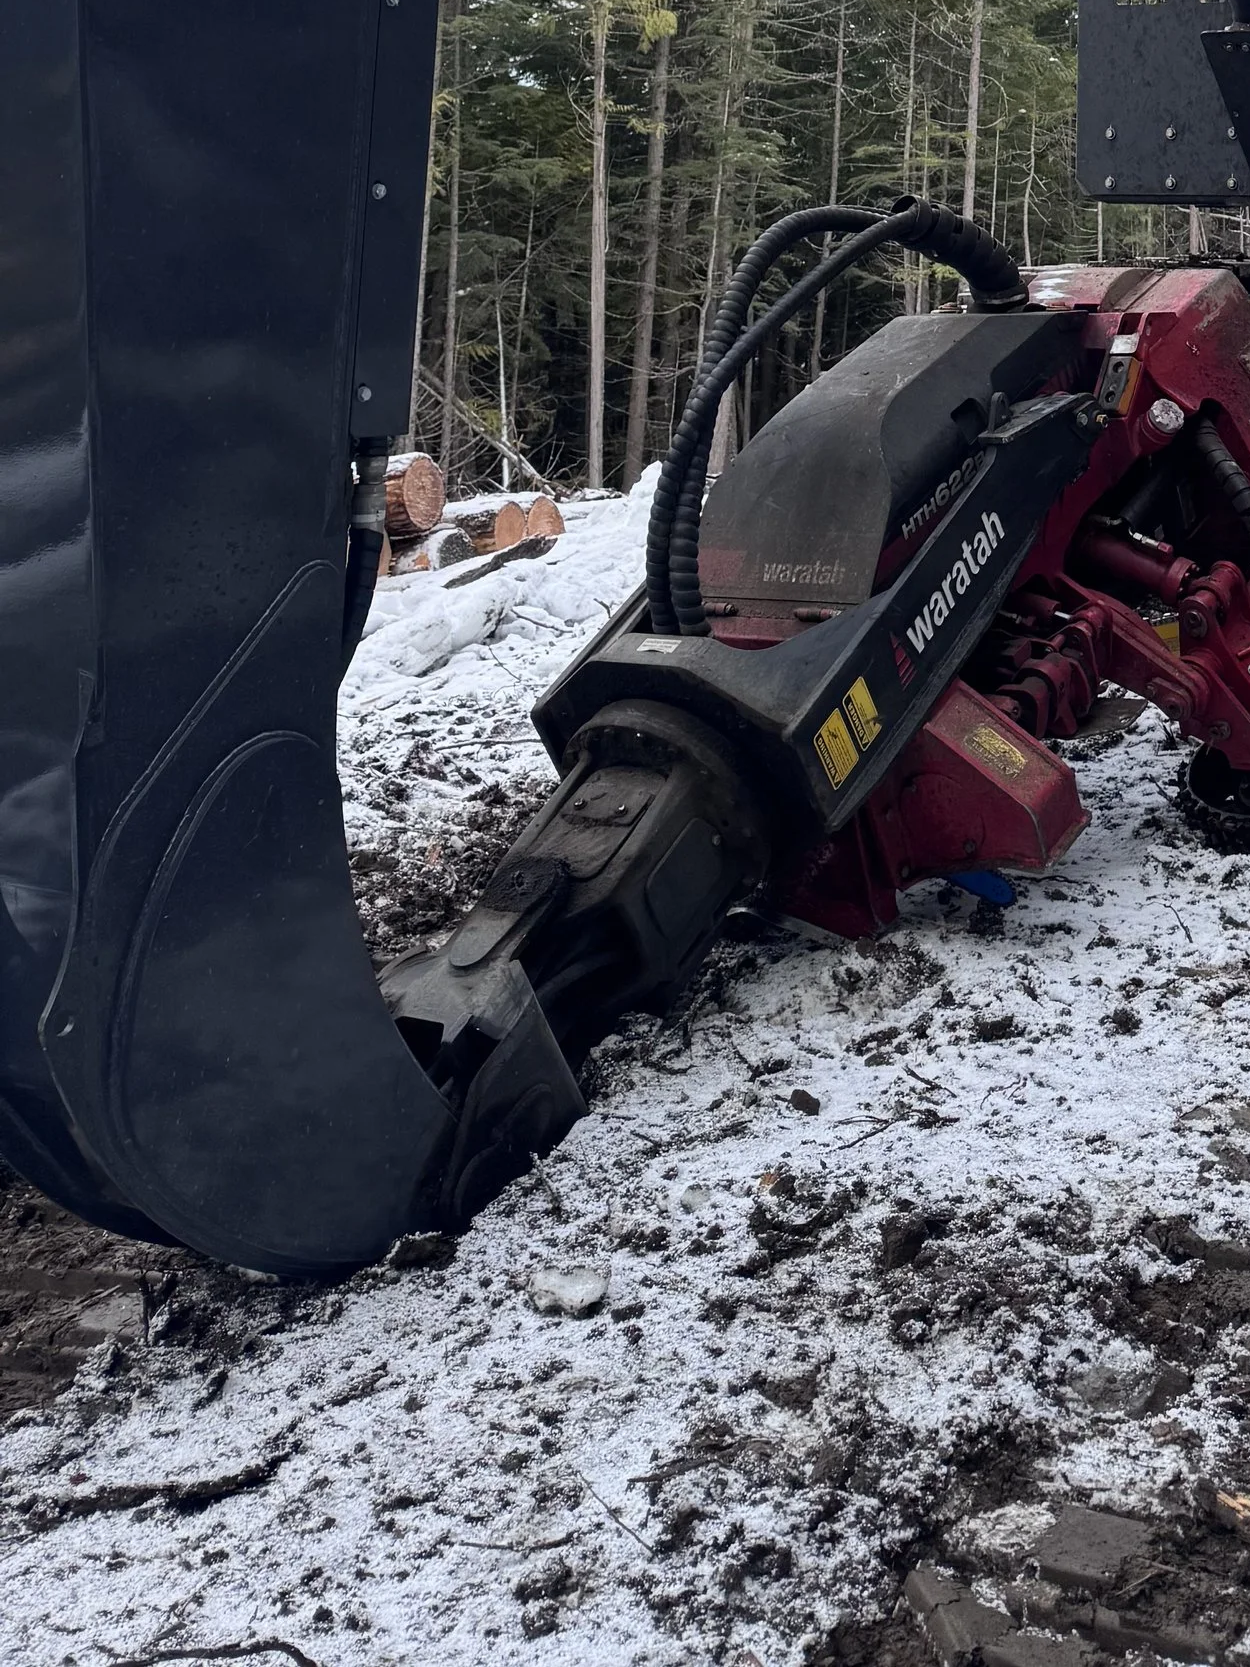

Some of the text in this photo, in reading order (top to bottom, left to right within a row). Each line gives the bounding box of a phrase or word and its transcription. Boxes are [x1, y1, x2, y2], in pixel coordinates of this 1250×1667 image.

[762, 559, 846, 585] waratah
[906, 511, 1005, 654] waratah
[848, 701, 868, 736] DANGER
[817, 737, 838, 777] WARNING
